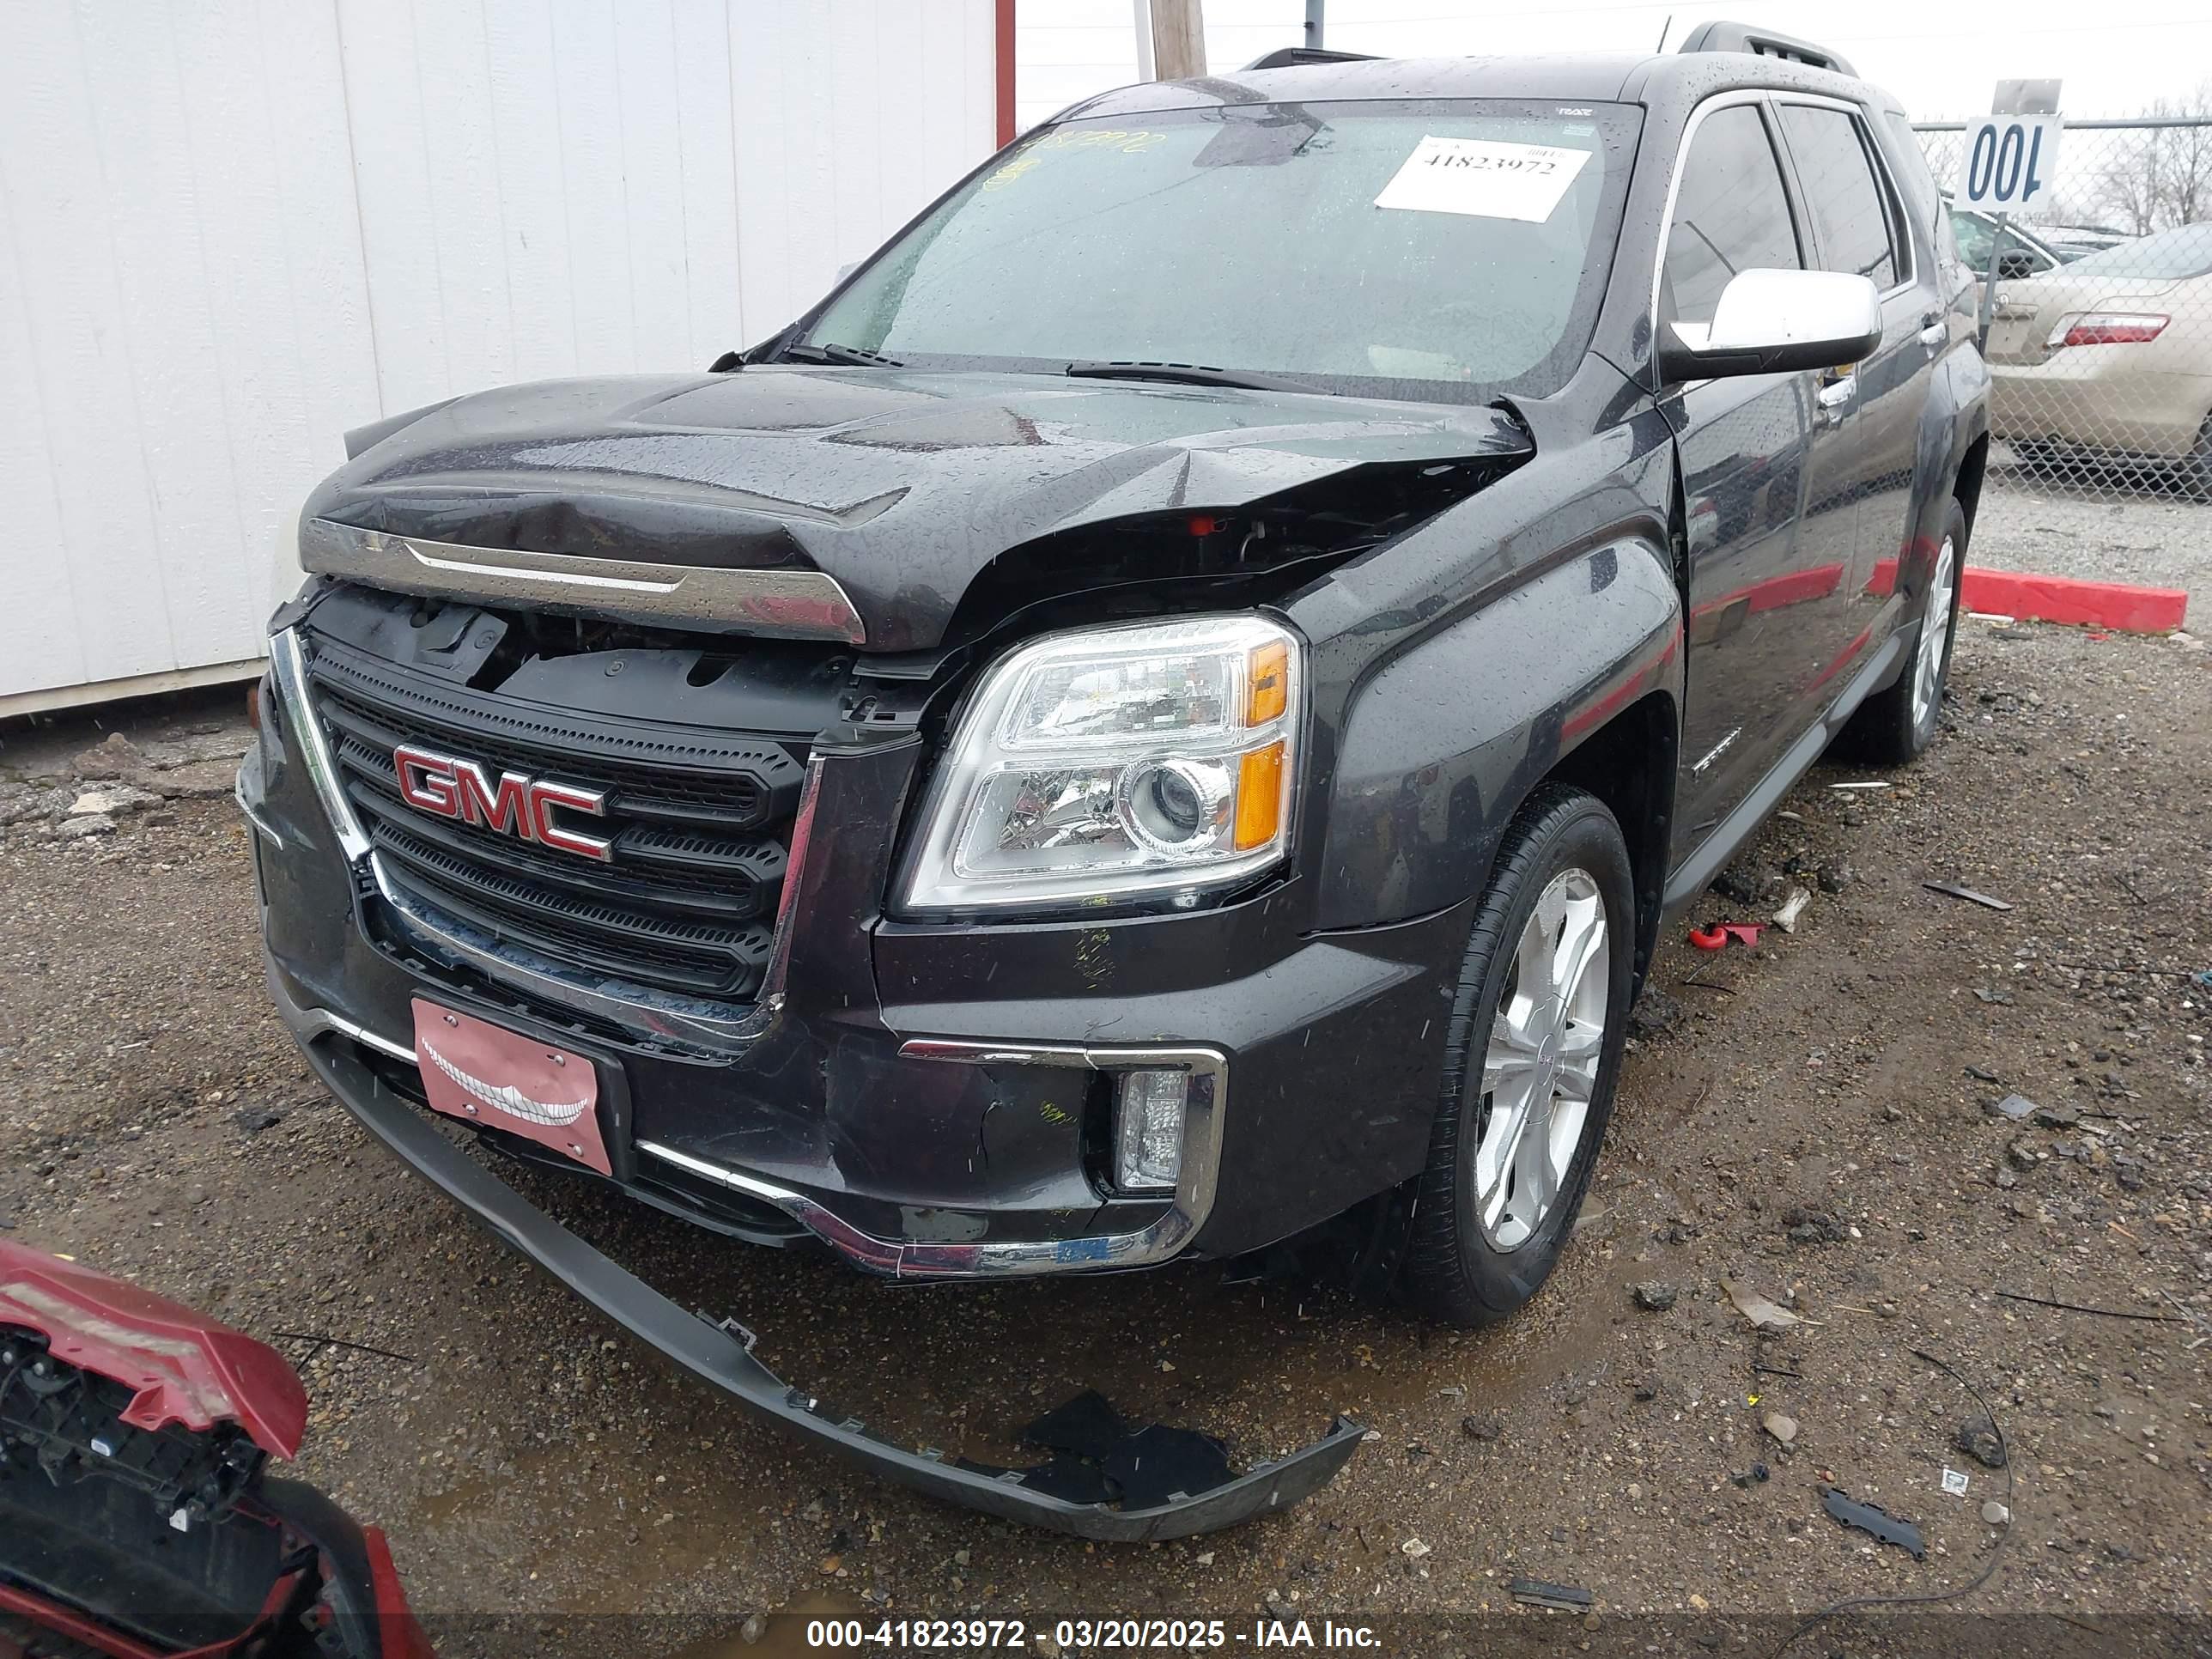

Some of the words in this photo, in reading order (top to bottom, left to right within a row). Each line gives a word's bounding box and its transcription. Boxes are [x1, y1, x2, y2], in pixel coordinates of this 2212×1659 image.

[1424, 153, 1557, 175] 41823972
[1968, 123, 2043, 202] 100
[394, 744, 612, 863] GMC
